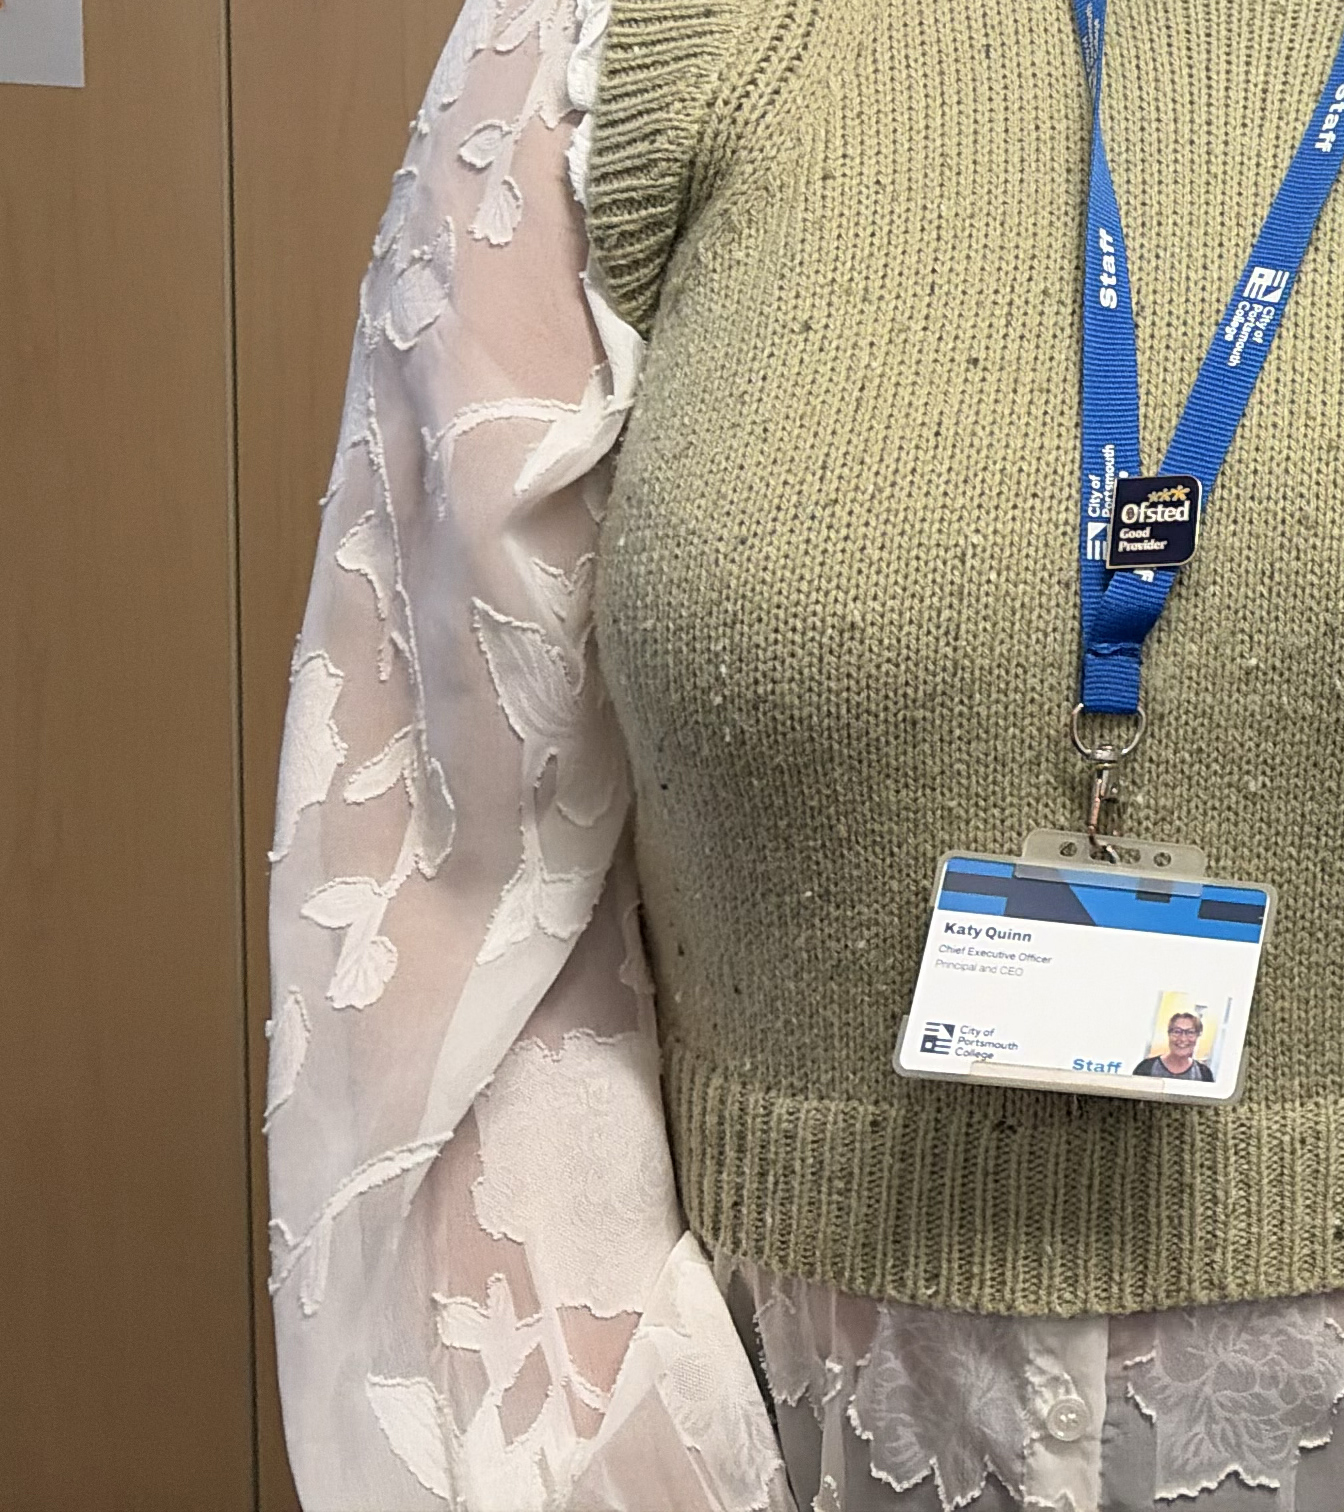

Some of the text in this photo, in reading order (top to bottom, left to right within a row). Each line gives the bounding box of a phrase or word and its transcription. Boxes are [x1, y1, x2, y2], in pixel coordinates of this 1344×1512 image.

[1099, 228, 1117, 309] Staff
[1252, 306, 1276, 344] City of
[1087, 473, 1104, 518] City of
[1121, 500, 1191, 524] Ofsted
[1119, 527, 1152, 539] Good
[1118, 539, 1168, 552] Provider
[944, 922, 1032, 942] Katy Quinn
[938, 944, 1052, 964] Chief Executive Officer
[935, 959, 1024, 977] Principal and CEO
[960, 1025, 995, 1037] City of
[957, 1036, 1018, 1050] Portsmouth
[954, 1047, 994, 1061] College
[1072, 1058, 1122, 1075] Staff
